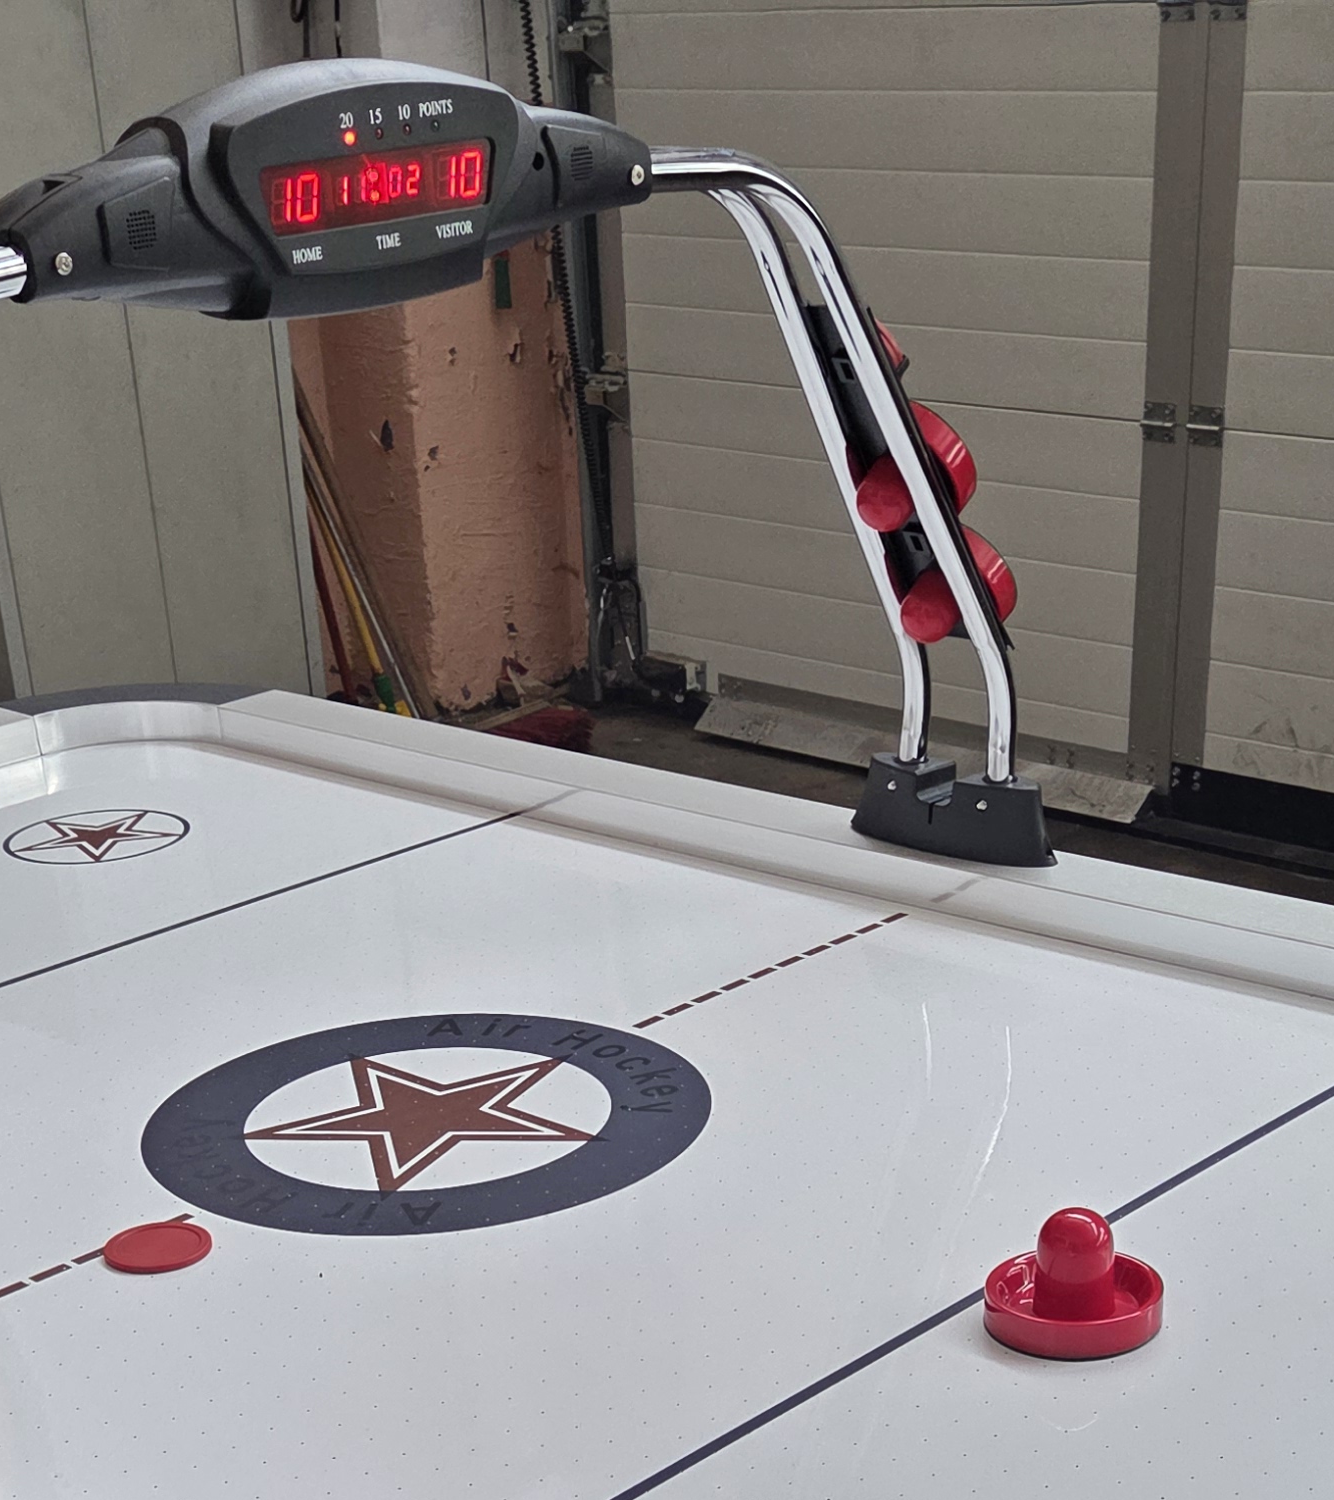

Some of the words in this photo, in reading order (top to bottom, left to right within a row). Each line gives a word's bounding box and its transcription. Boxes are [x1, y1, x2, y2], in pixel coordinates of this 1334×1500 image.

[338, 111, 354, 129] 20
[369, 107, 383, 125] 15
[397, 103, 412, 121] 10
[418, 98, 454, 118] POINTS
[284, 172, 319, 223] 10
[449, 150, 482, 199] 10
[291, 246, 324, 265] HOME
[375, 232, 402, 251] TIME
[435, 220, 474, 240] VISITOR
[426, 1017, 532, 1037] Air
[552, 1028, 680, 1114] Hockey
[321, 1200, 443, 1226] Air
